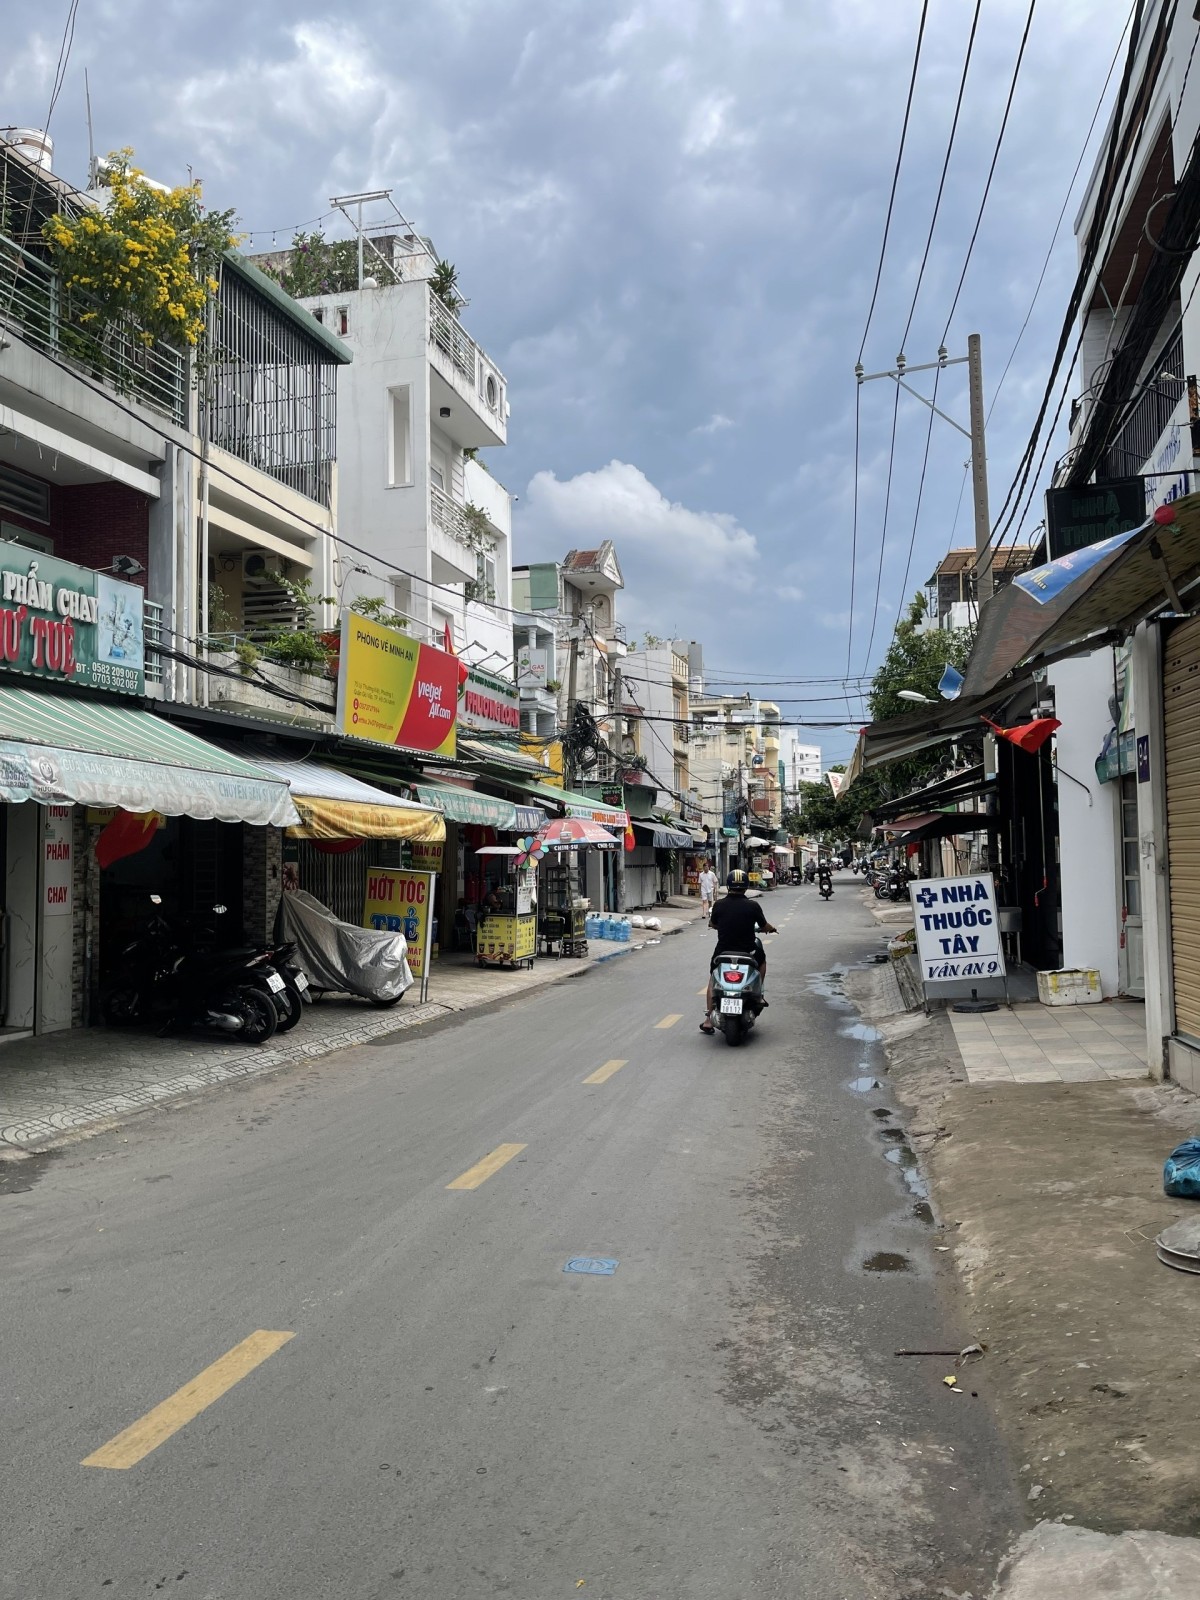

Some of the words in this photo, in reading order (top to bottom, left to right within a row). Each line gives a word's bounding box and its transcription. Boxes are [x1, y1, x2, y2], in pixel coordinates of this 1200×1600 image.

[2, 561, 53, 612] PHẨM
[56, 588, 98, 624] CHAY
[30, 615, 76, 680] TUỆ
[389, 643, 404, 660] MINH
[404, 650, 414, 662] AN
[46, 837, 70, 860] PHẨM
[48, 886, 68, 904] CHAY
[368, 873, 395, 901] HỚT
[400, 876, 426, 904] TÓC
[941, 880, 989, 904] NHÀ
[920, 904, 992, 931] THUỐC
[939, 934, 980, 955] TÂY
[928, 962, 960, 979] VÂN
[962, 962, 985, 976] AN
[987, 960, 998, 974] 9
